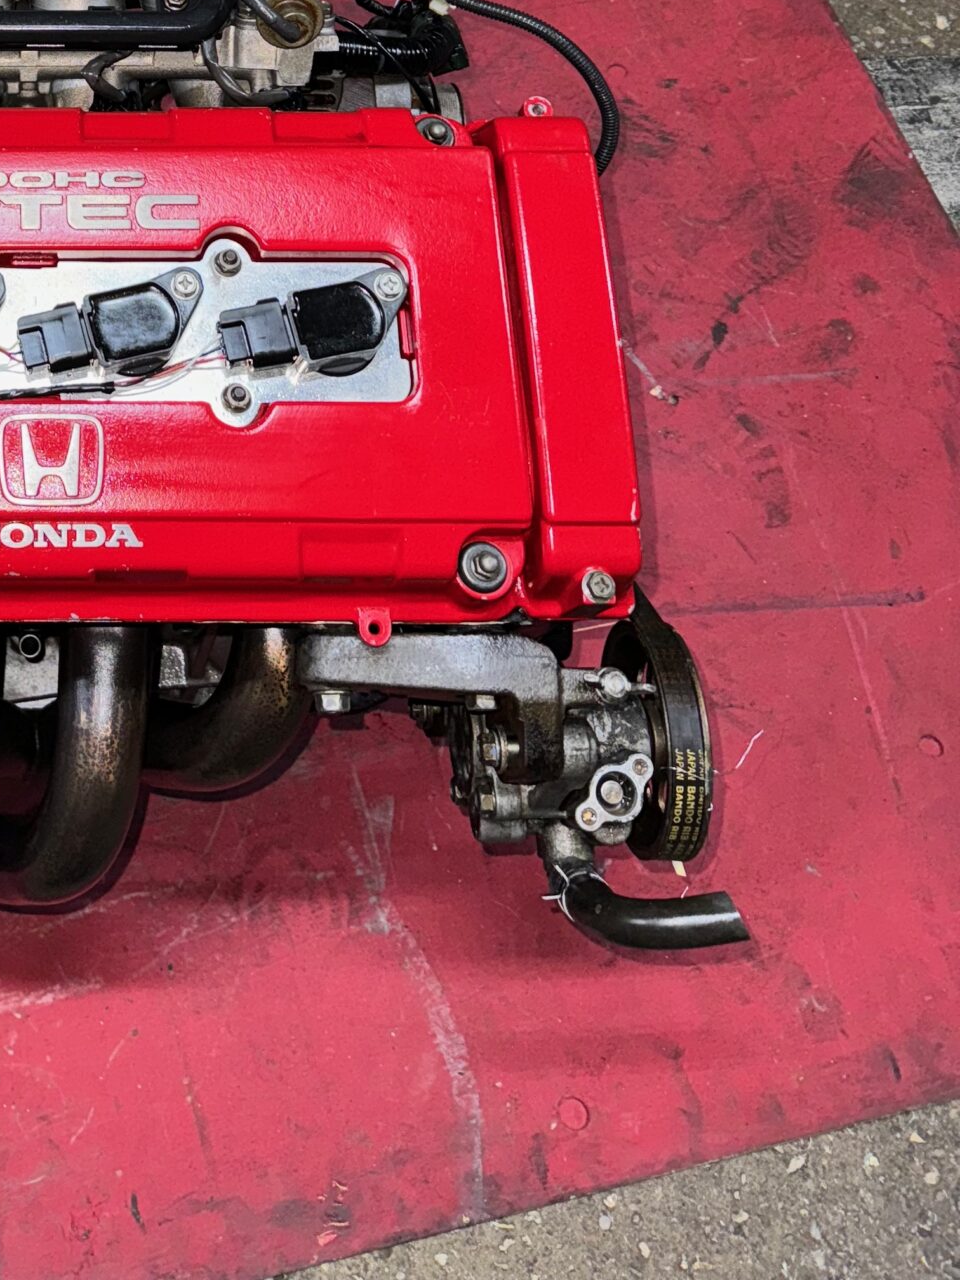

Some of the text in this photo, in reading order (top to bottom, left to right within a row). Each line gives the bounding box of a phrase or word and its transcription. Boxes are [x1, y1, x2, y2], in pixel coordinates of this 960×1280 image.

[675, 748, 685, 781] JAPAN
[686, 749, 696, 781] JAPAN
[673, 786, 684, 824] BANDO
[684, 786, 696, 824] BANDO
